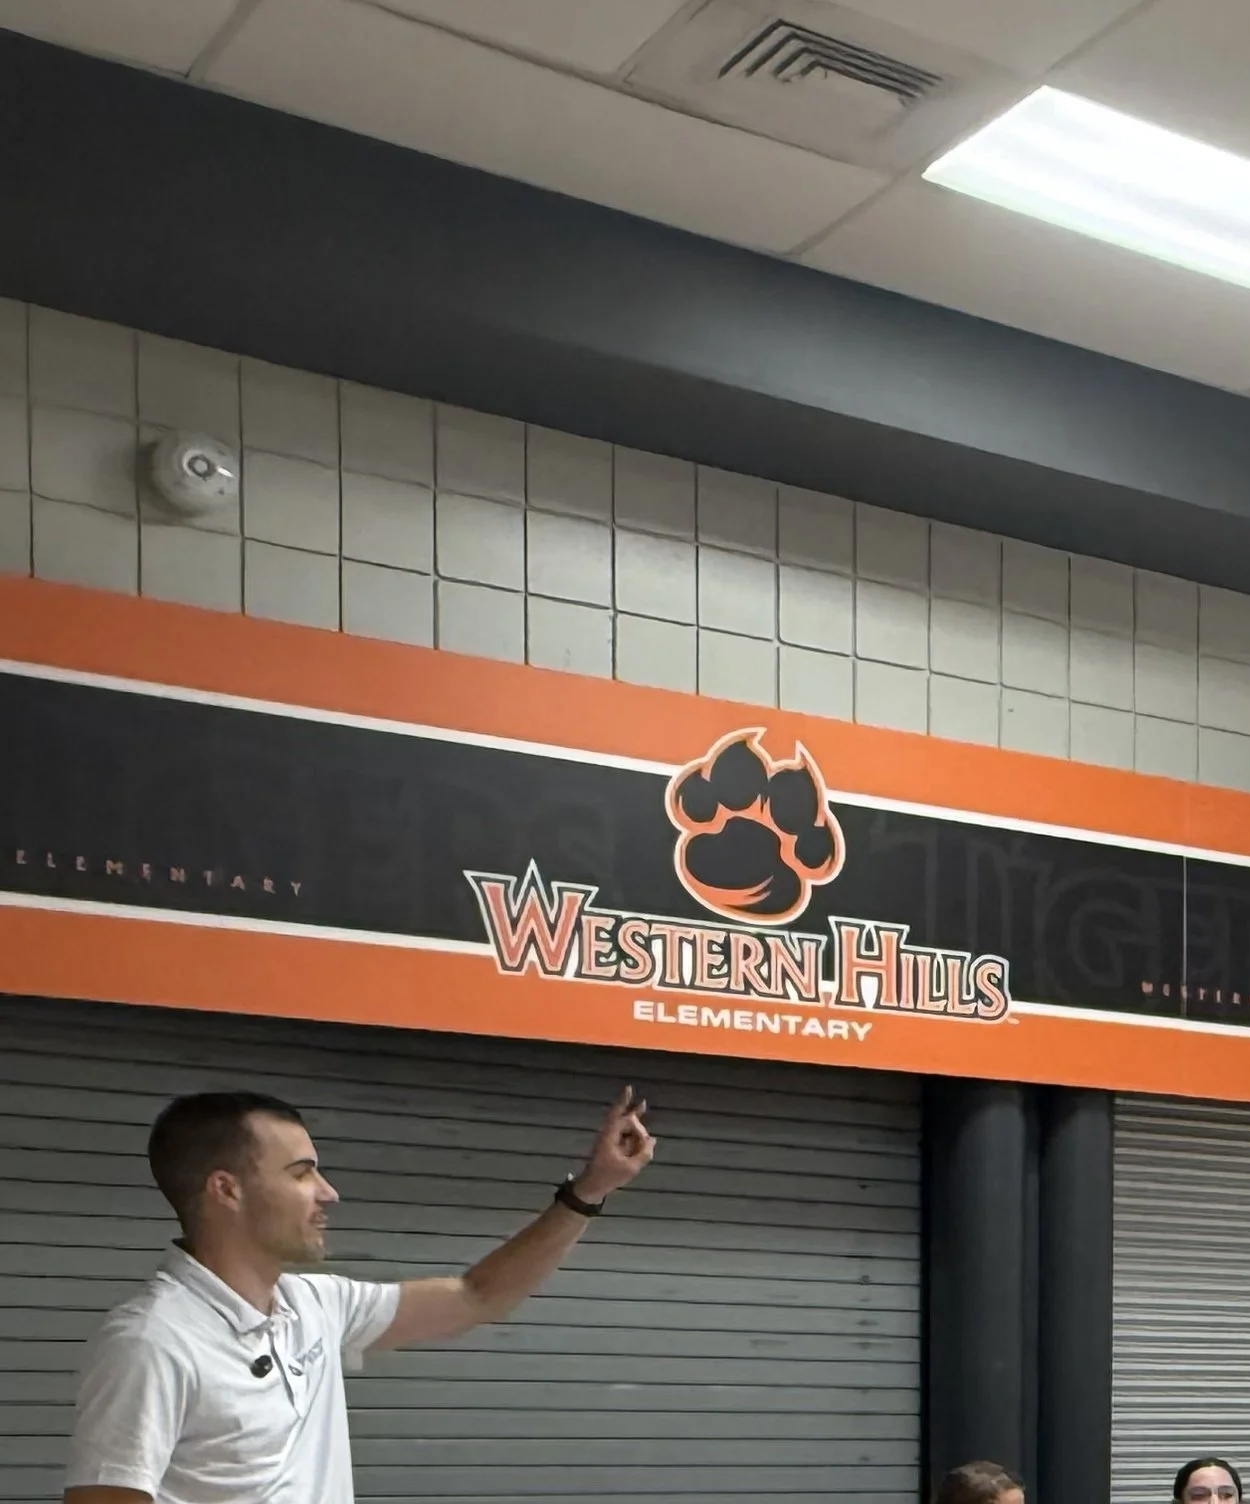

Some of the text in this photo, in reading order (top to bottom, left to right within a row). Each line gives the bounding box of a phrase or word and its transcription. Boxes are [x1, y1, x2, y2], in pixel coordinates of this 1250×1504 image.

[16, 849, 302, 896] ELEMENTARY
[463, 859, 1012, 1024] WESTERN HILLS
[633, 1000, 873, 1042] ELEMENTARY
